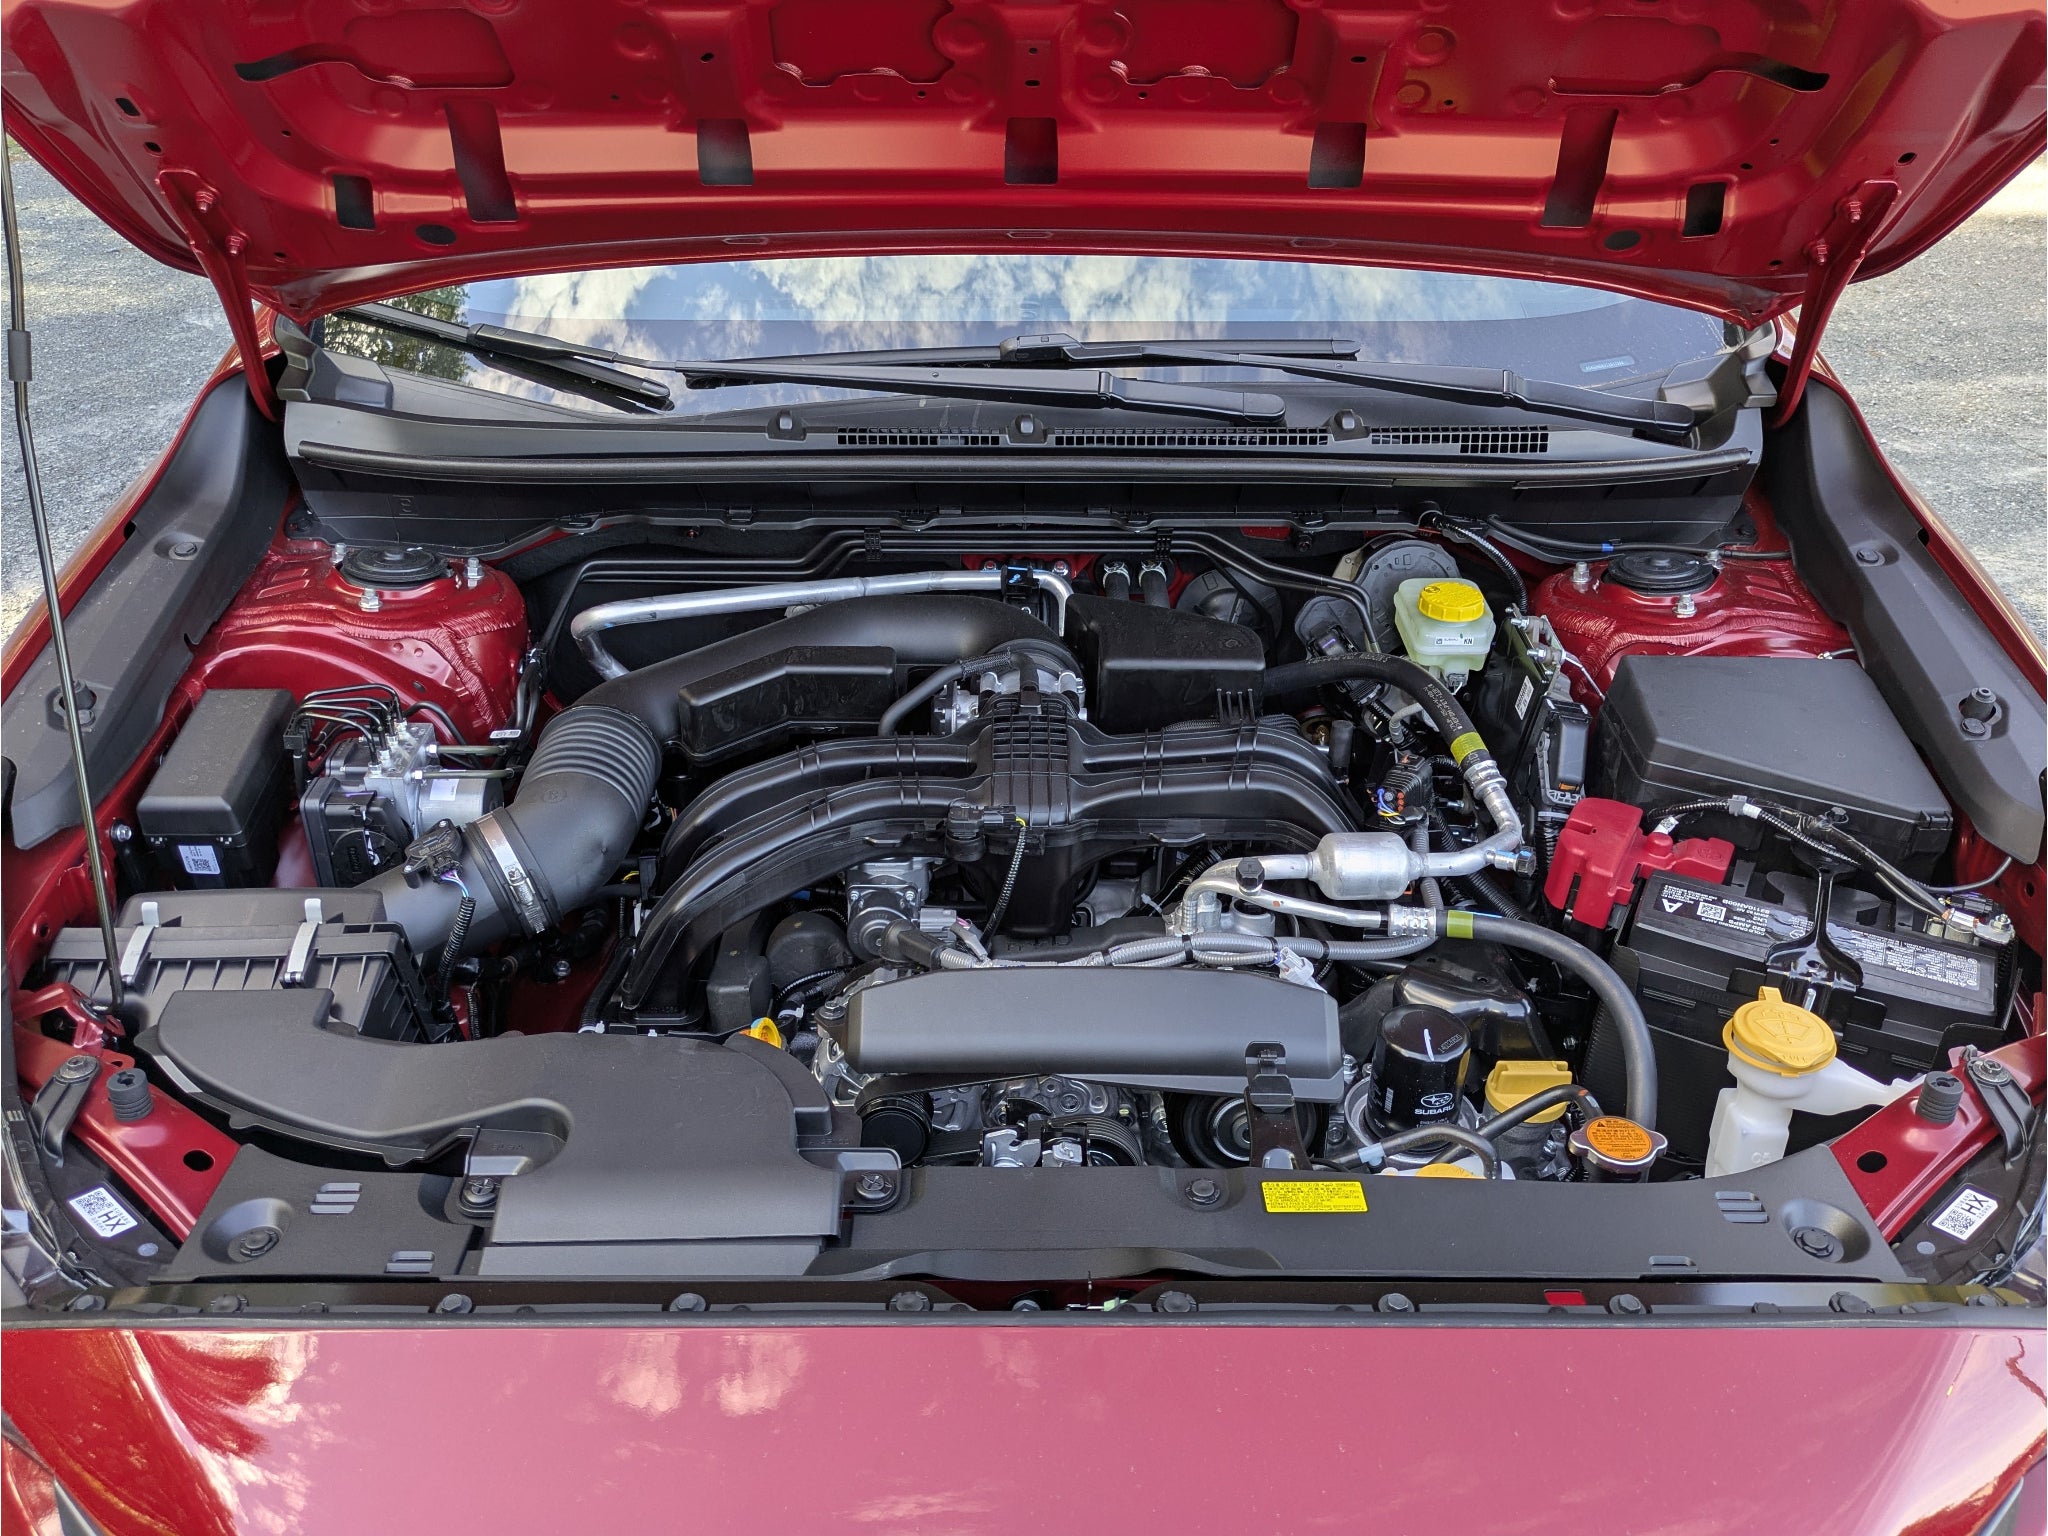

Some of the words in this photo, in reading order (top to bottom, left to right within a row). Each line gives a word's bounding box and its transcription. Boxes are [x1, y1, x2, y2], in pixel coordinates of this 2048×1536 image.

[1662, 898, 1683, 913] A
[1701, 916, 1718, 924] AMPS
[1728, 919, 1751, 929] AMPS
[1748, 928, 1766, 936] COLD
[1414, 1102, 1455, 1115] SUBARU
[1961, 1195, 1989, 1215] HX
[98, 1210, 126, 1232] HX
